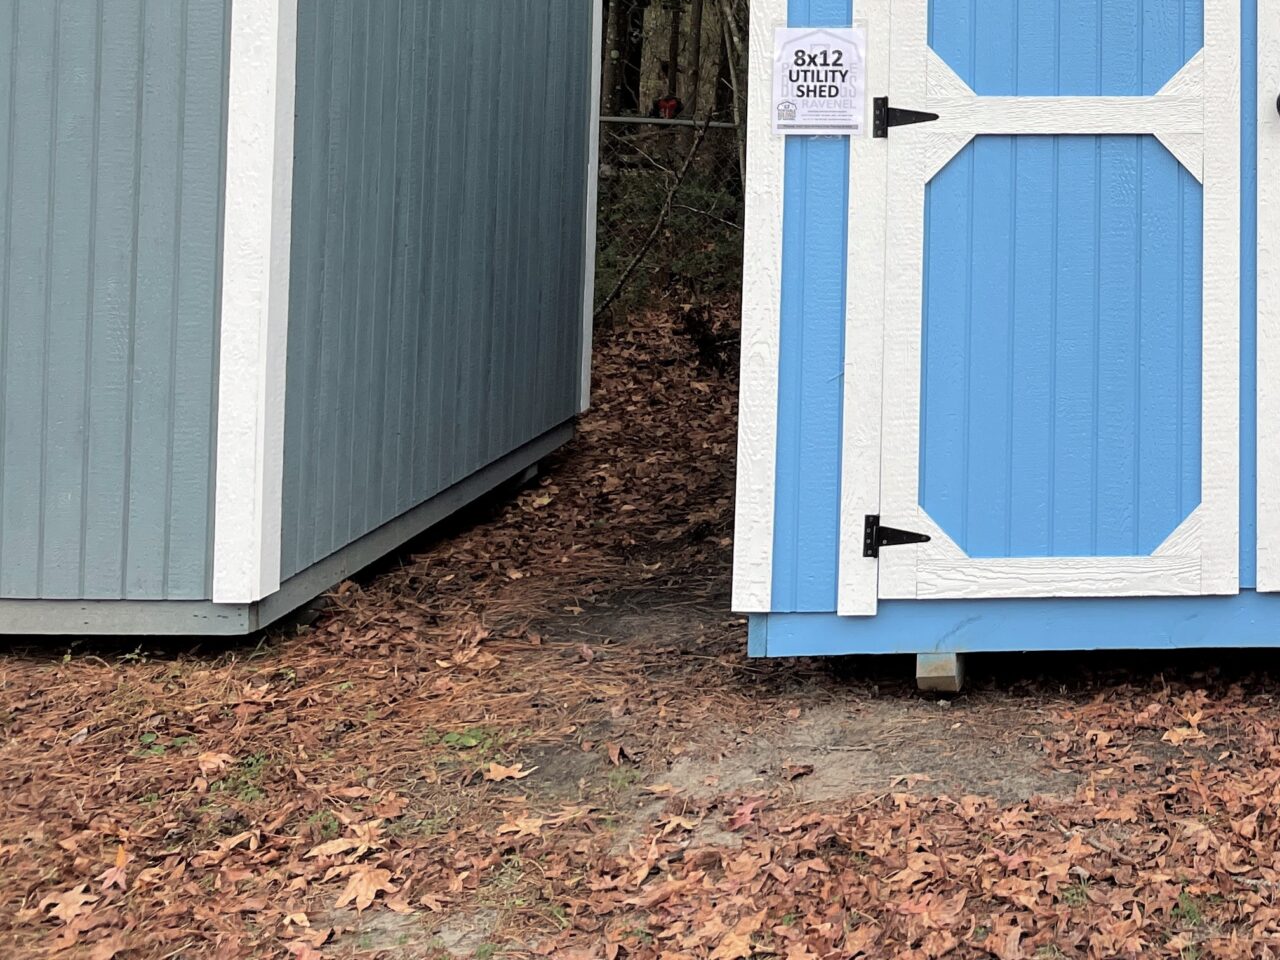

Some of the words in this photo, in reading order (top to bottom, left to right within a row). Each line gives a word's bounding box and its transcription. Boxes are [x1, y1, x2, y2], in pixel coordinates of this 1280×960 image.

[793, 49, 844, 67] 8x12
[788, 69, 849, 83] UTILITY
[796, 84, 840, 98] SHED
[801, 99, 857, 109] RAVENEL
